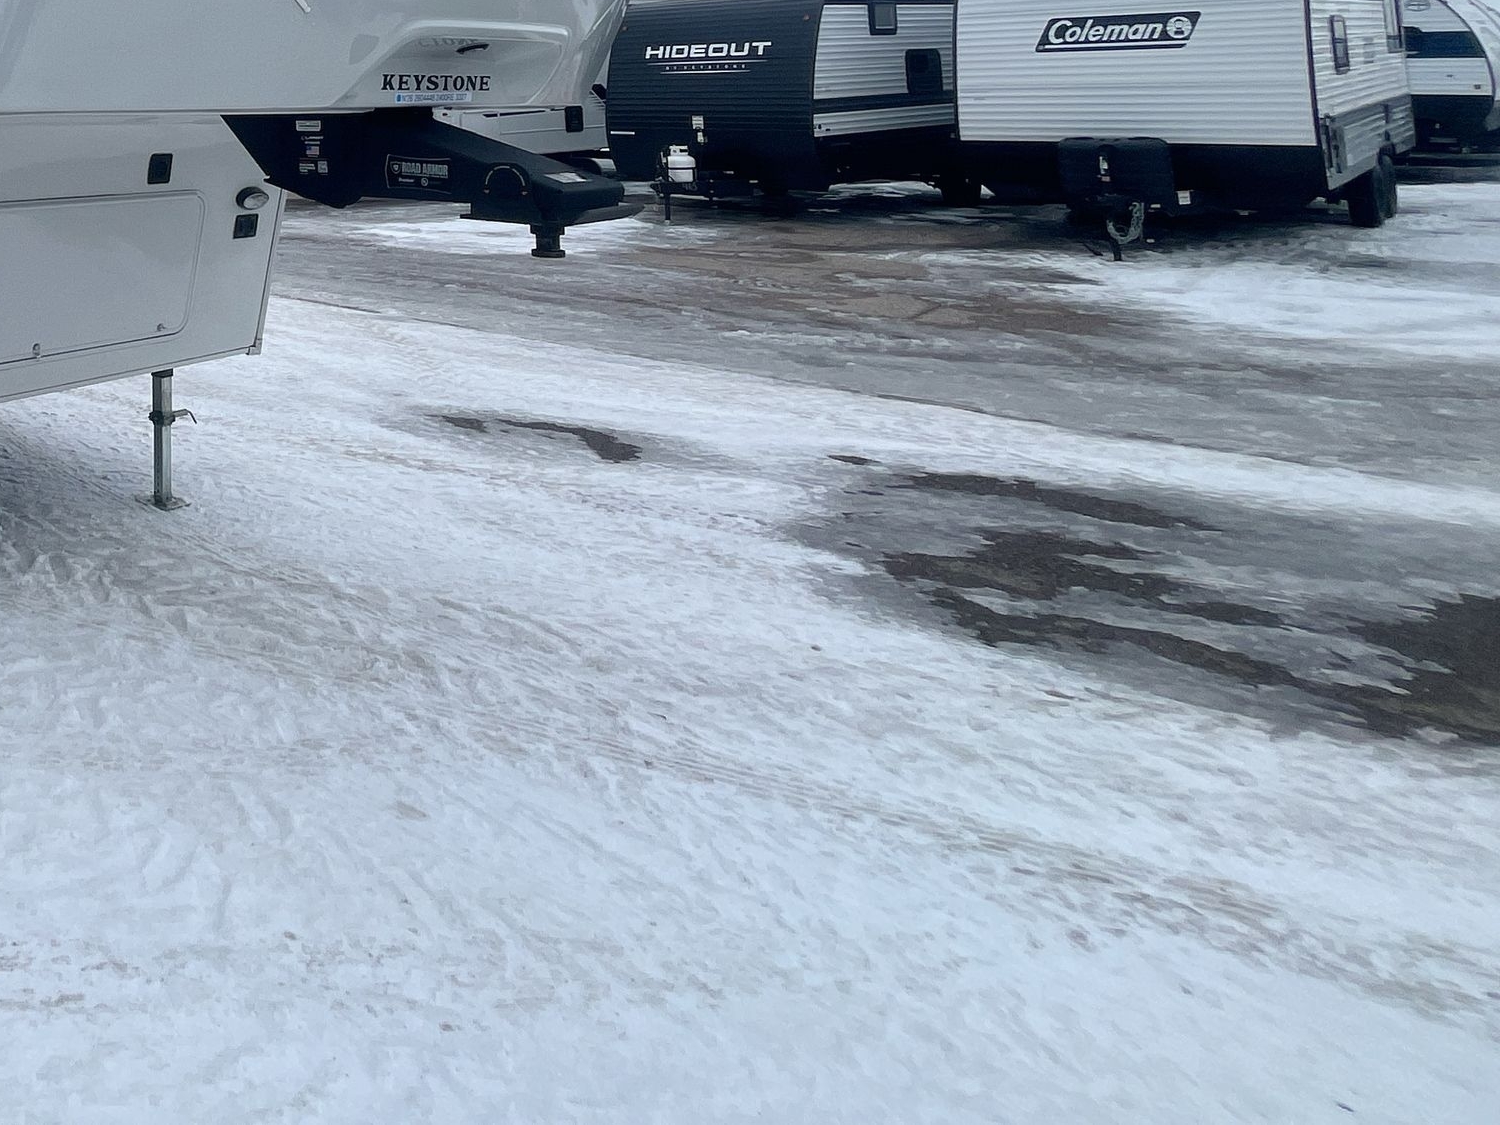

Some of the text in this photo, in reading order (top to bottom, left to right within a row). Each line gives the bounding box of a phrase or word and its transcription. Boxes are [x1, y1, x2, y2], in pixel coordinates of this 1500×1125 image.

[1048, 18, 1164, 44] Coleman
[645, 41, 772, 59] HIDEOUT
[380, 73, 491, 91] KEYSTONE
